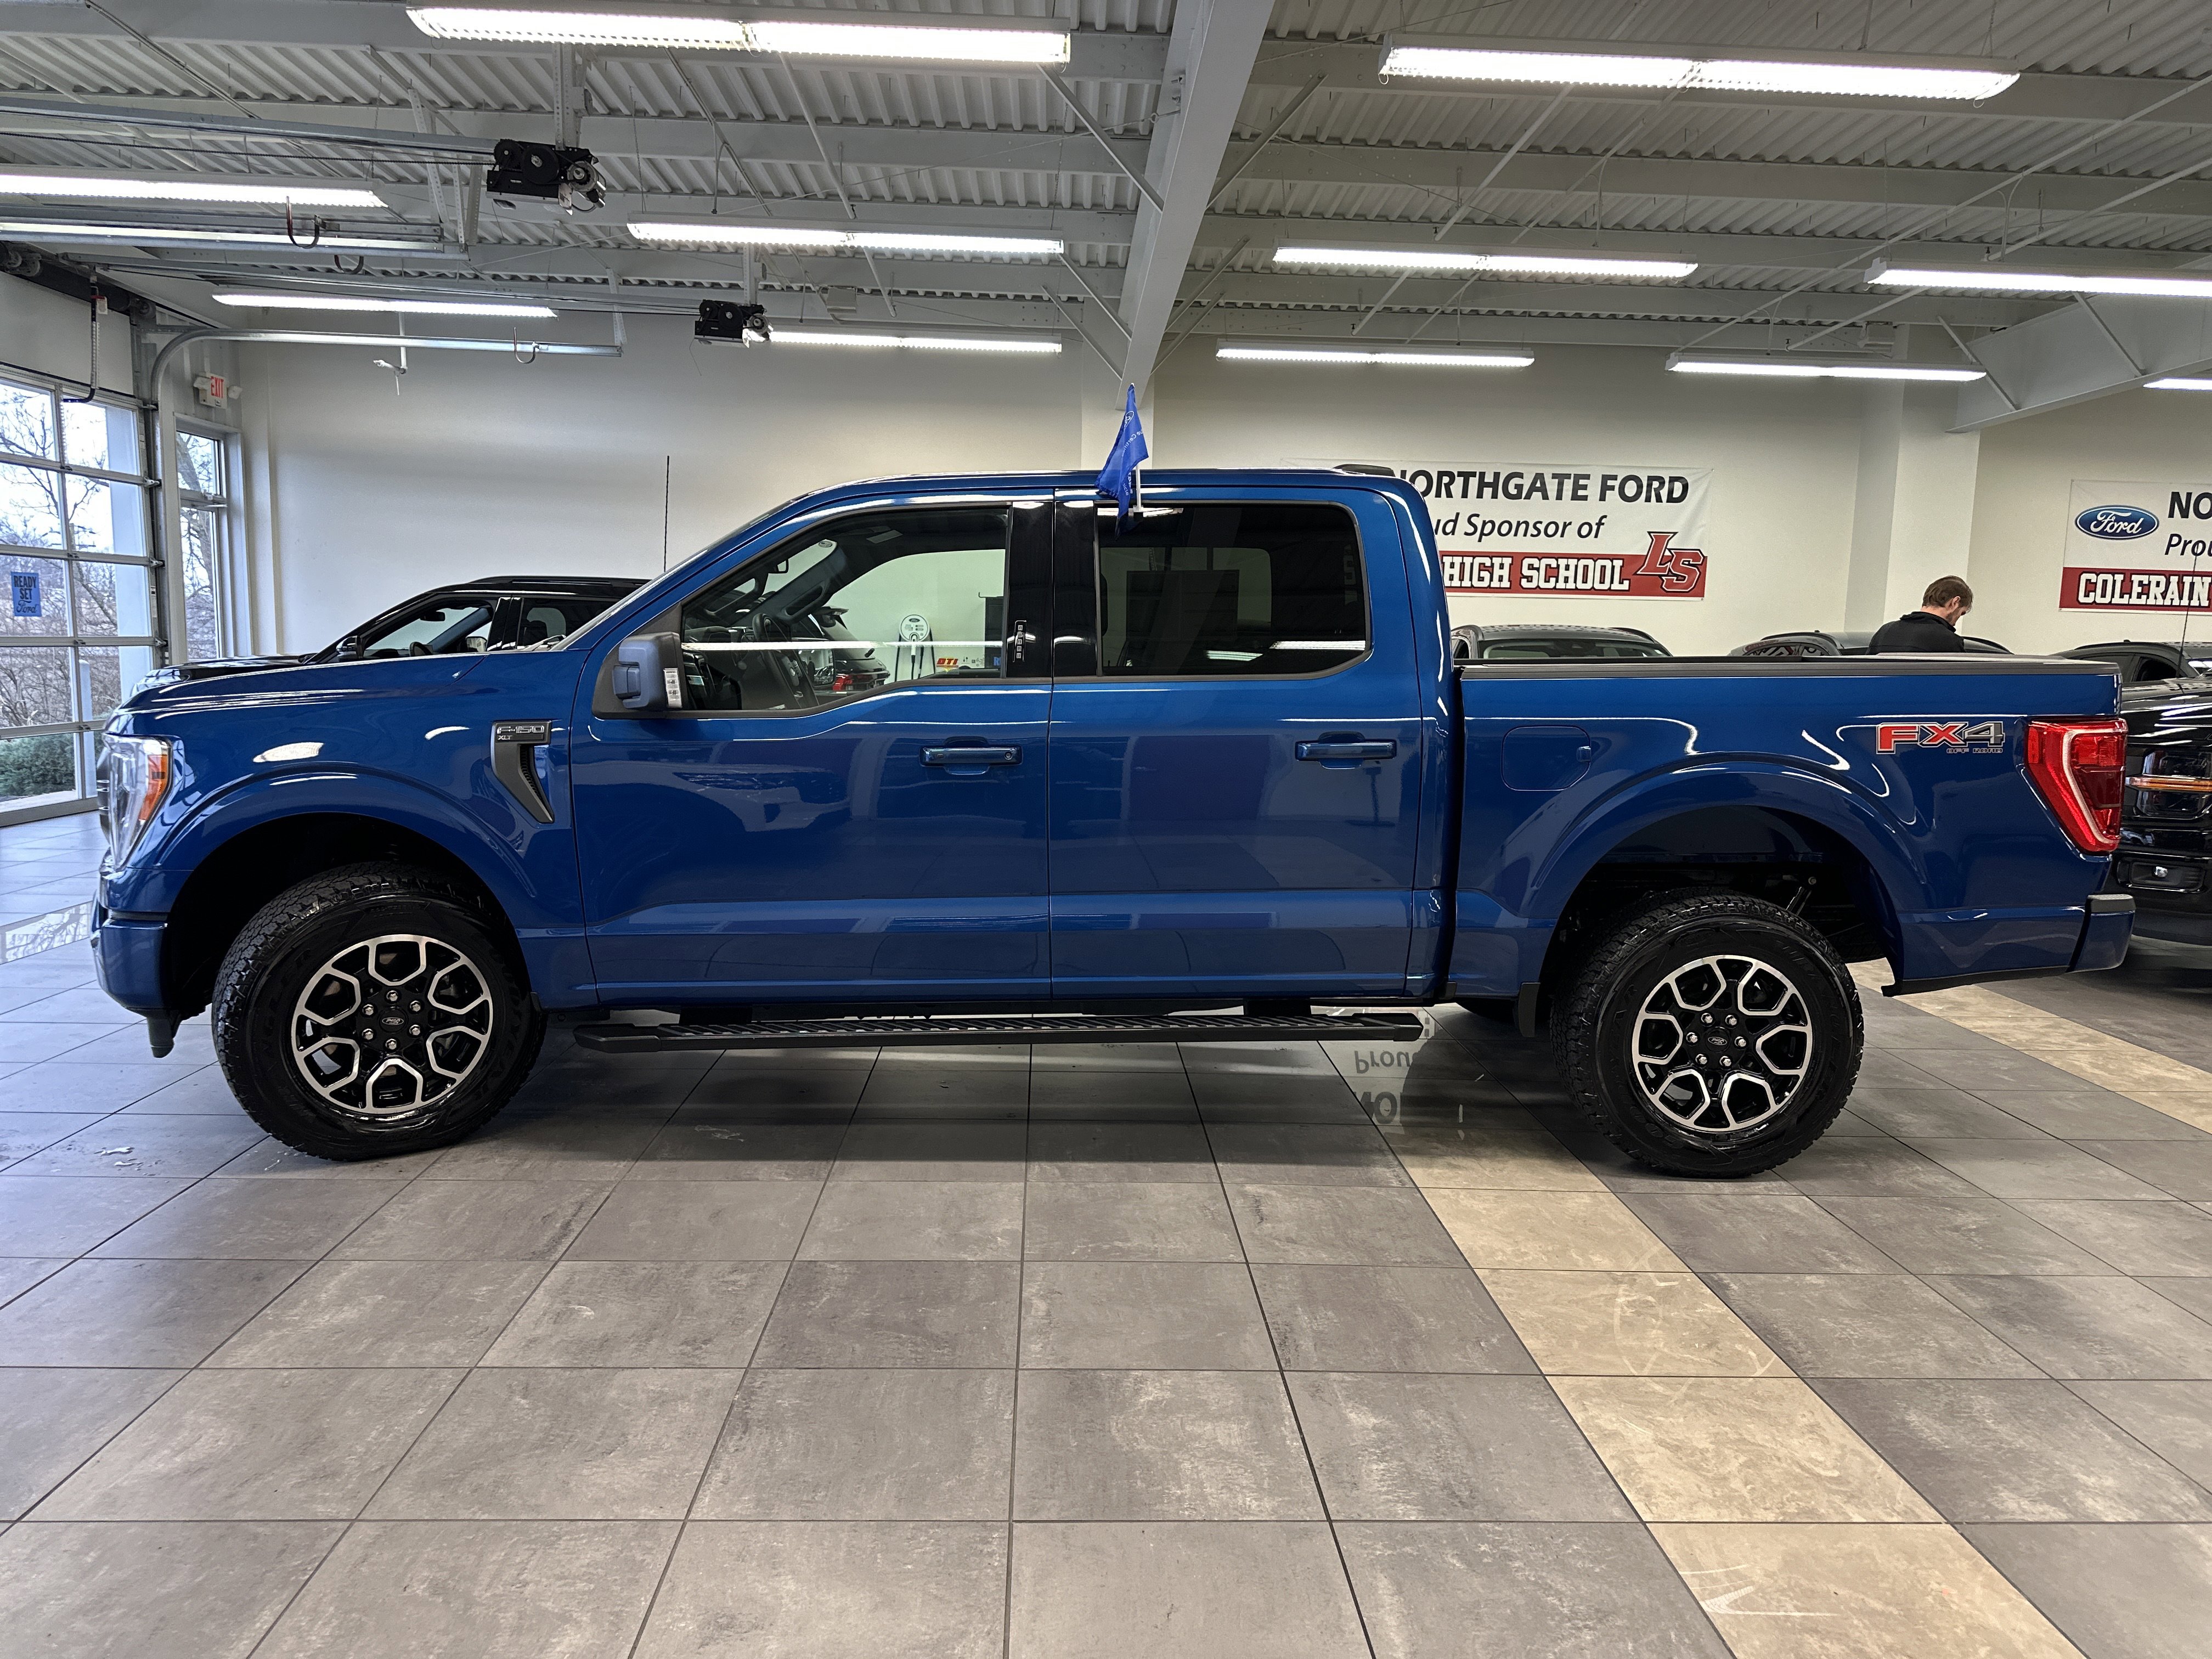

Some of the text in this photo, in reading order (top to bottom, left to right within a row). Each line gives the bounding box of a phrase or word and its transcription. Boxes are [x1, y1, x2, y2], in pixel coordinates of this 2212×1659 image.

[211, 376, 224, 398] EXIT
[1598, 474, 1689, 504] FORD
[1464, 513, 1573, 543] Sponsor
[1577, 515, 1607, 540] of
[2090, 510, 2144, 534] Ford
[14, 575, 37, 588] READY
[1442, 555, 1630, 591] HIGH SCHOOL
[20, 588, 32, 600] SET
[2078, 572, 2211, 607] COLERAIN
[16, 600, 38, 613] Ford
[1876, 721, 2006, 754] FX4
